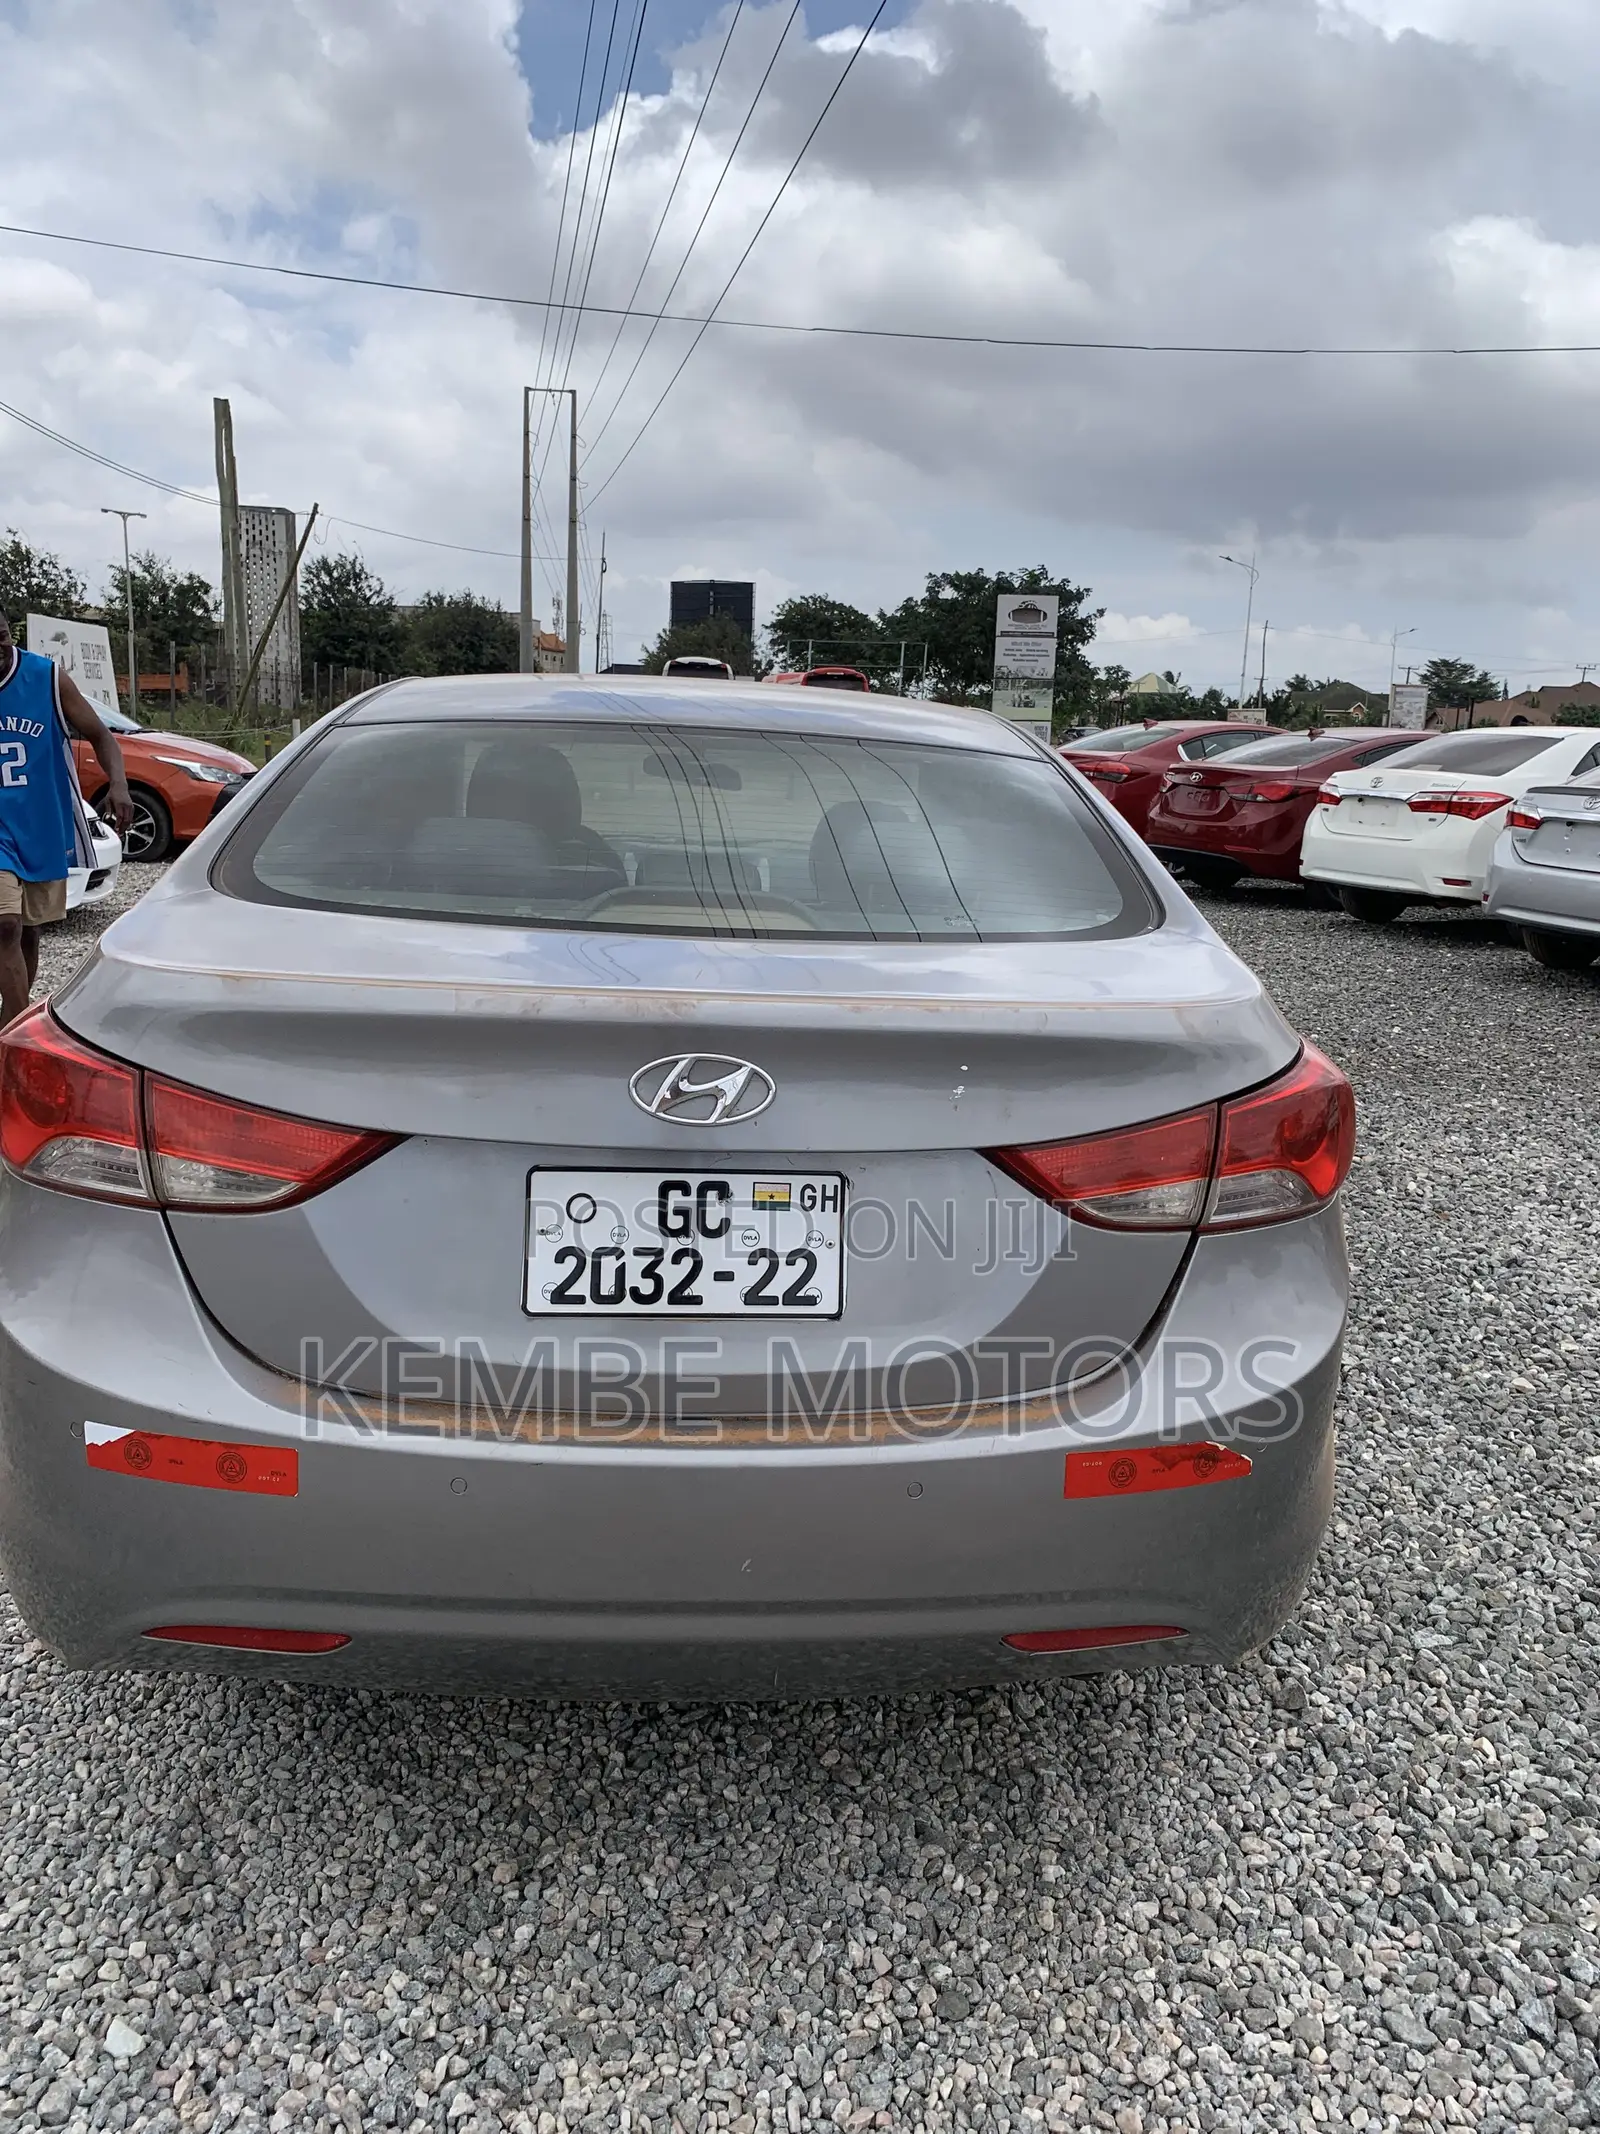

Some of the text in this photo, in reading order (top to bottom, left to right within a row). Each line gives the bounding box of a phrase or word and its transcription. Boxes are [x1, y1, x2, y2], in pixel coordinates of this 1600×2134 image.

[657, 1179, 732, 1239] GC
[800, 1183, 839, 1213] GH
[549, 1246, 818, 1306] 2032-22
